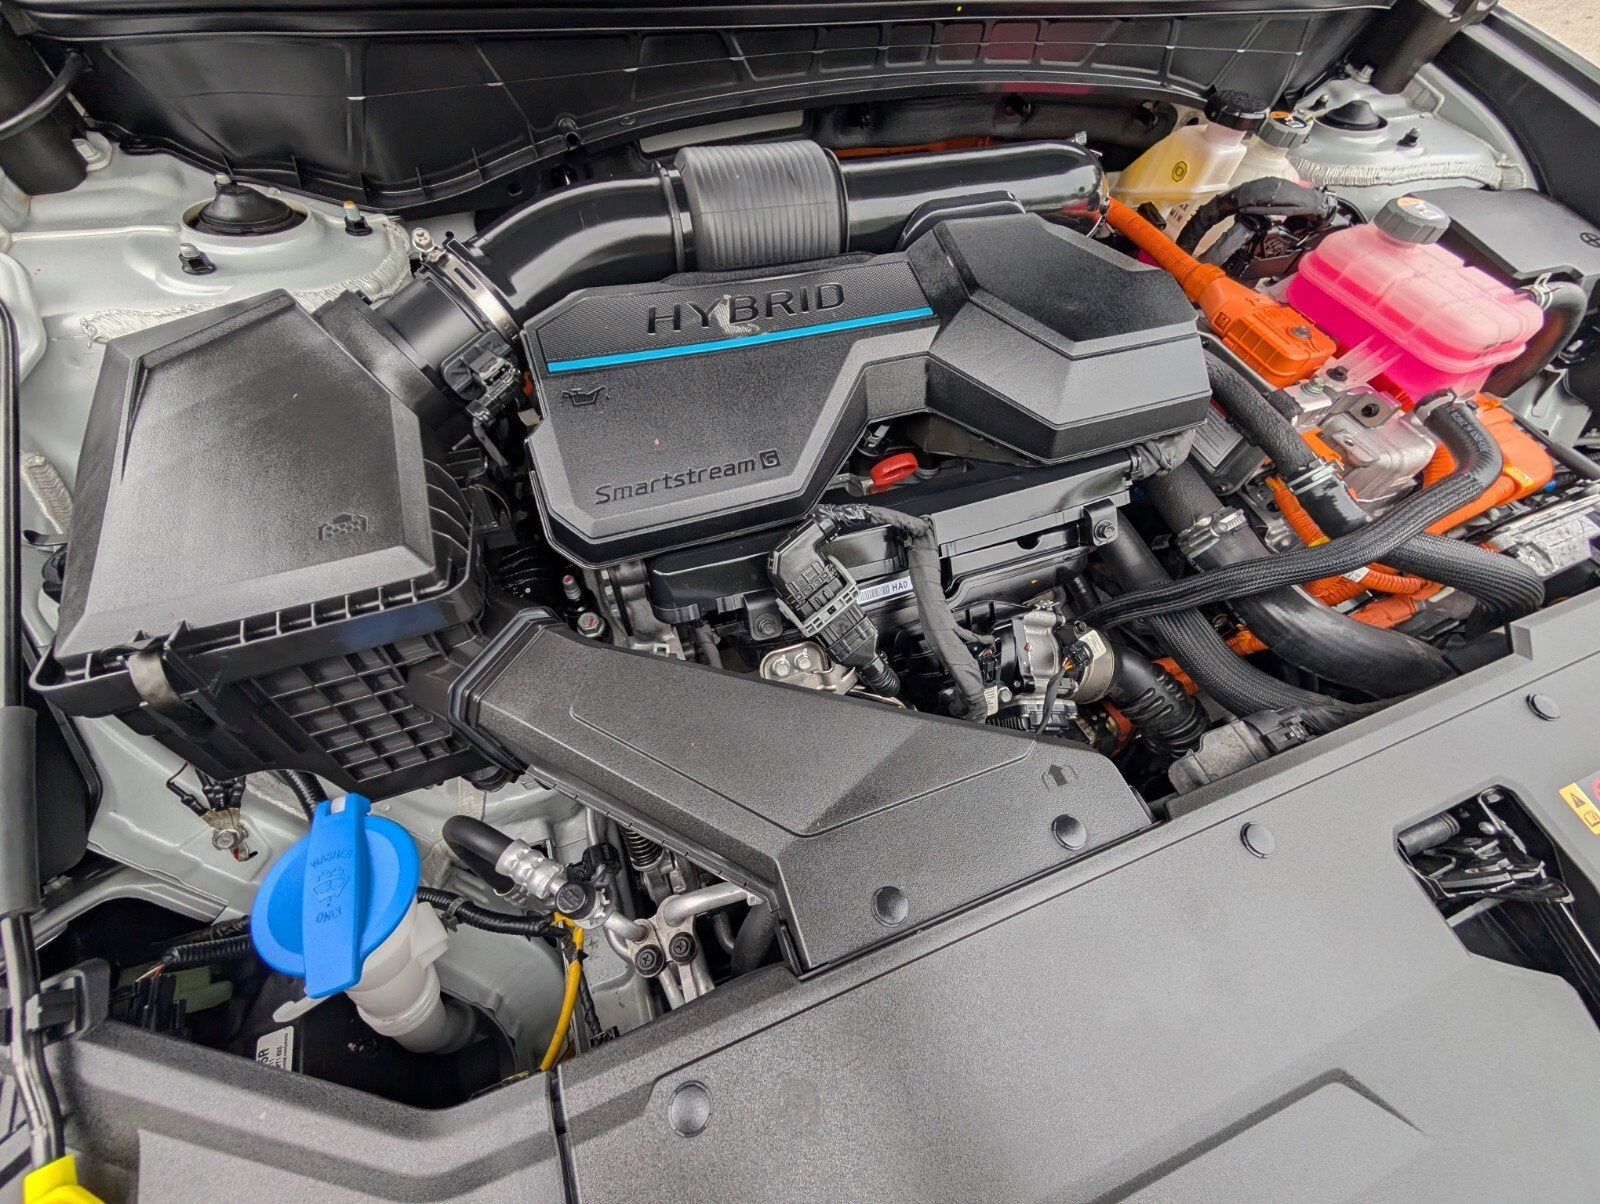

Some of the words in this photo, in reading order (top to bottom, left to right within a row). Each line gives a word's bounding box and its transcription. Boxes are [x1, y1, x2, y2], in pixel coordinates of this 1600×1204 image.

[647, 282, 846, 336] HYBRID
[595, 457, 756, 505] Smartstream
[310, 848, 354, 869] WASHER
[315, 905, 341, 924] ONLY
